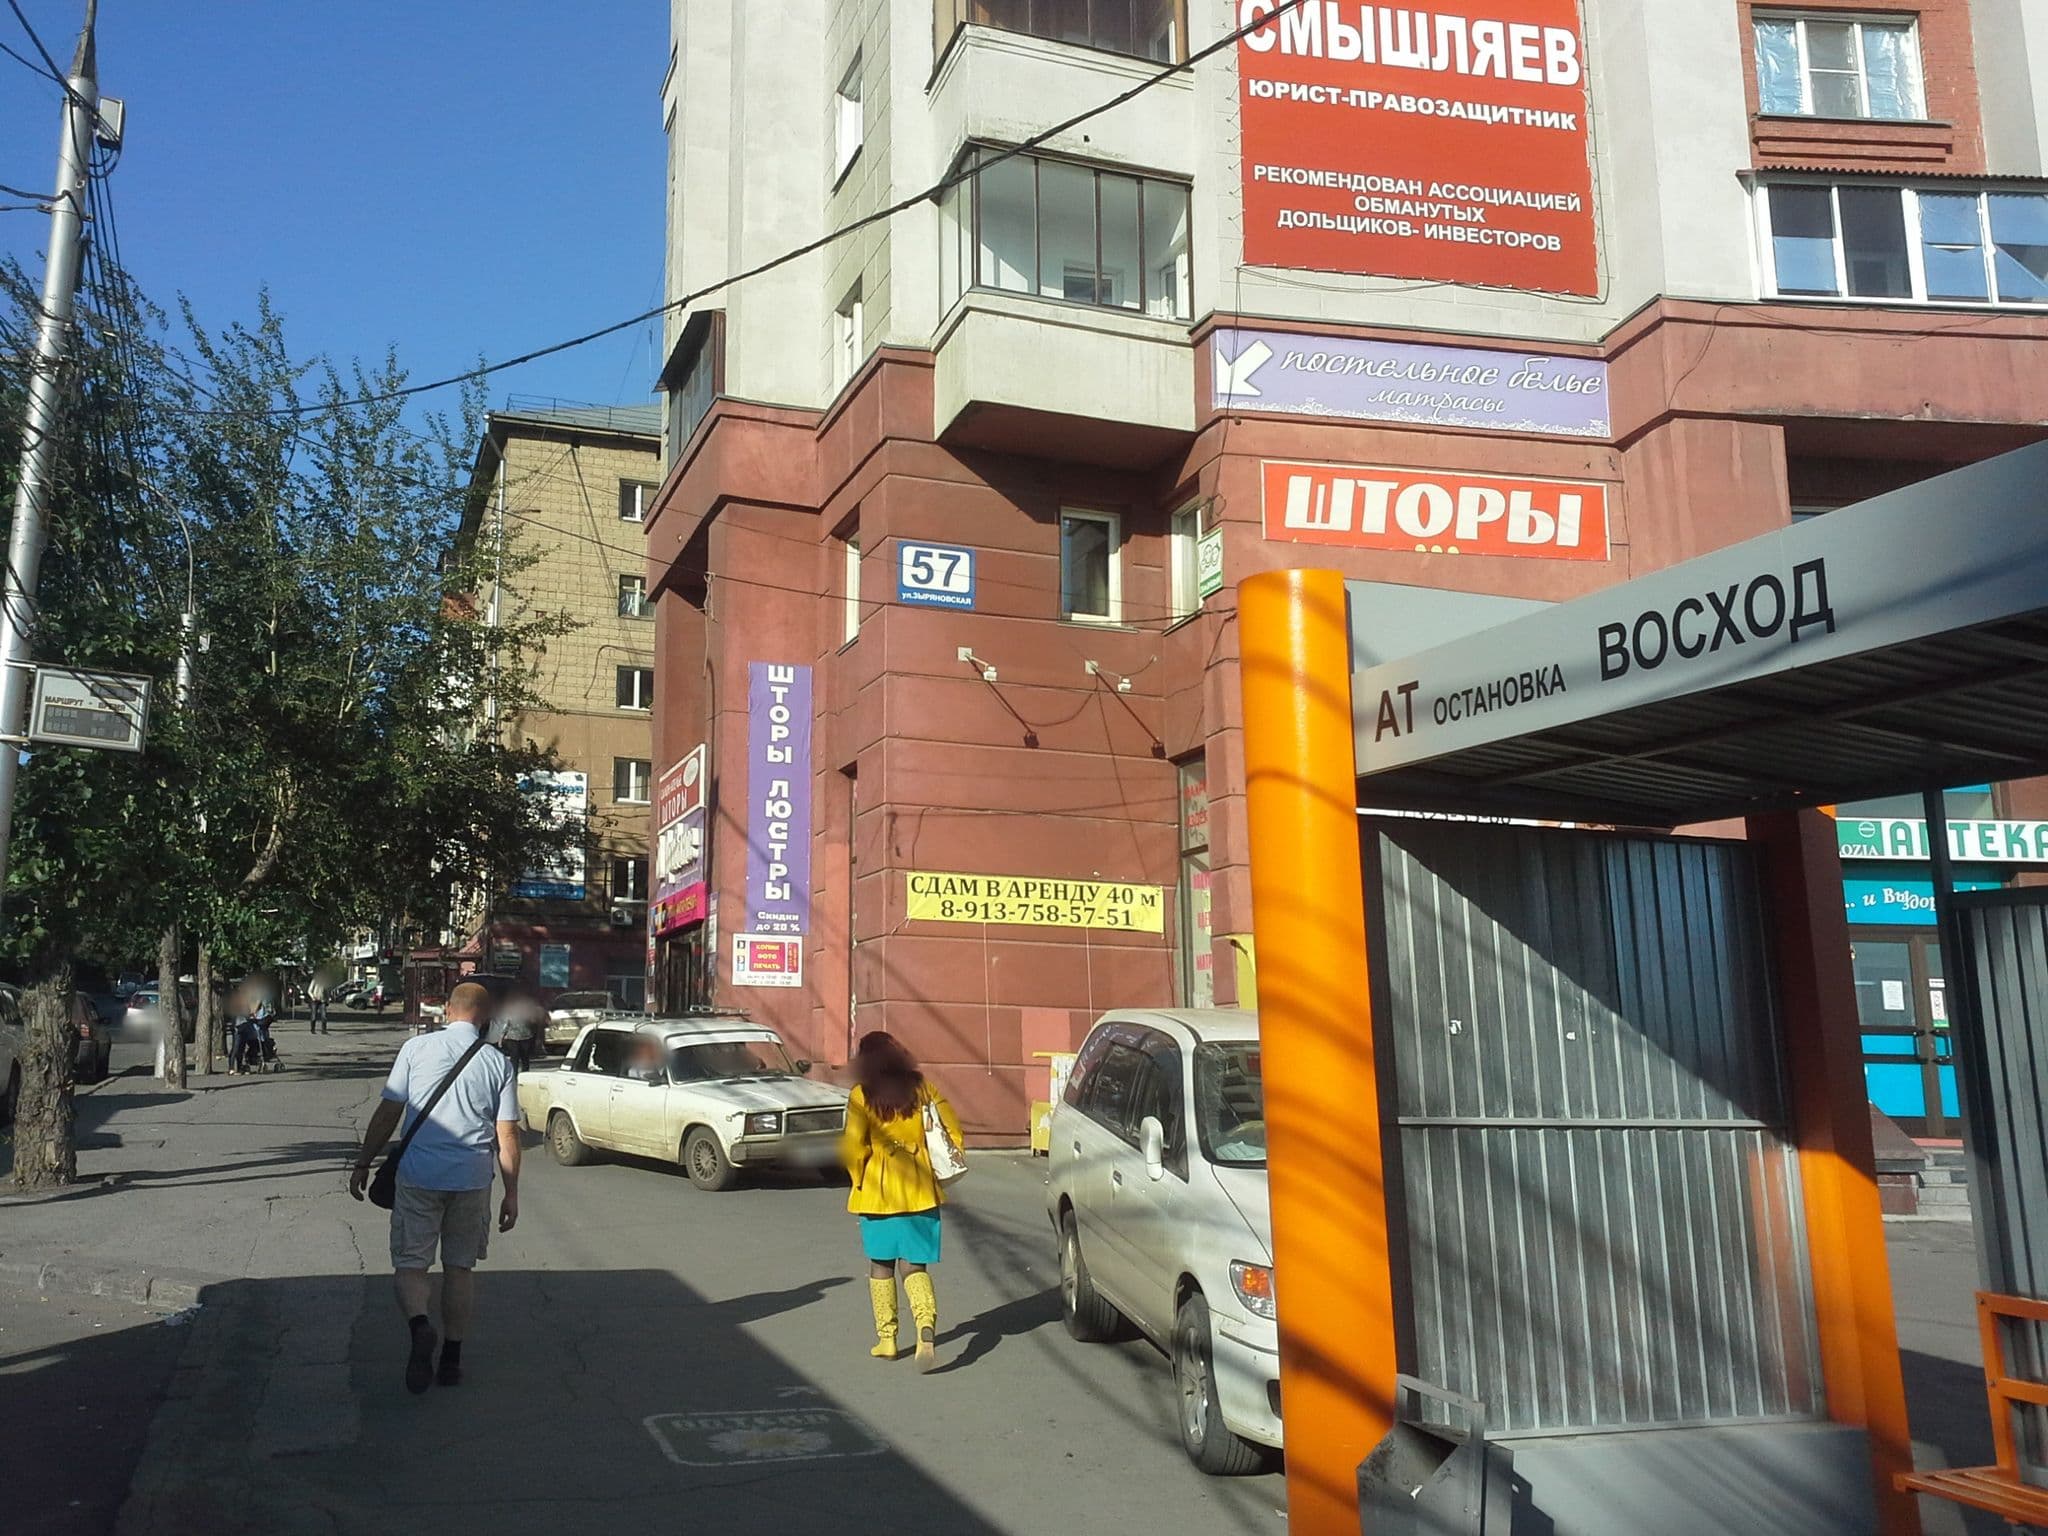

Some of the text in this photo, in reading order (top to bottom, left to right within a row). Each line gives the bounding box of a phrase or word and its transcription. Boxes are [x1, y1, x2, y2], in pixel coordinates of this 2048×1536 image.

[1240, 0, 1580, 86] СМЫШЛЯЕВ
[1248, 78, 1577, 131] ЮРИСТ-ПРАВОЗАЩИТНИК
[1253, 164, 1581, 212] РЕКОМЕНДОВАН АССОЦИАЦИЕЙ
[1354, 195, 1486, 223] ОБМАНУТЫХ
[1277, 209, 1561, 251] ДОЛЬЩИКОВ- ИНВЕСТОРОВ
[1279, 348, 1602, 394] постельное белье
[1367, 388, 1506, 419] матрасы
[1284, 474, 1583, 547] ШТОРЫ
[911, 550, 961, 588] 57
[1597, 557, 1837, 682] ВОСХОД
[767, 664, 795, 765] ШТОРЫ
[1375, 663, 1567, 743] АТ ОСТАНОВКА
[764, 779, 793, 901] ЛЮСТРЫ
[910, 875, 979, 897] СДАМ
[986, 881, 1001, 898] В
[1007, 881, 1101, 906] АРЕНДУ
[1106, 886, 1134, 905] 40
[940, 899, 1134, 927] 8-913-758-57-51
[757, 911, 800, 921] Скидки
